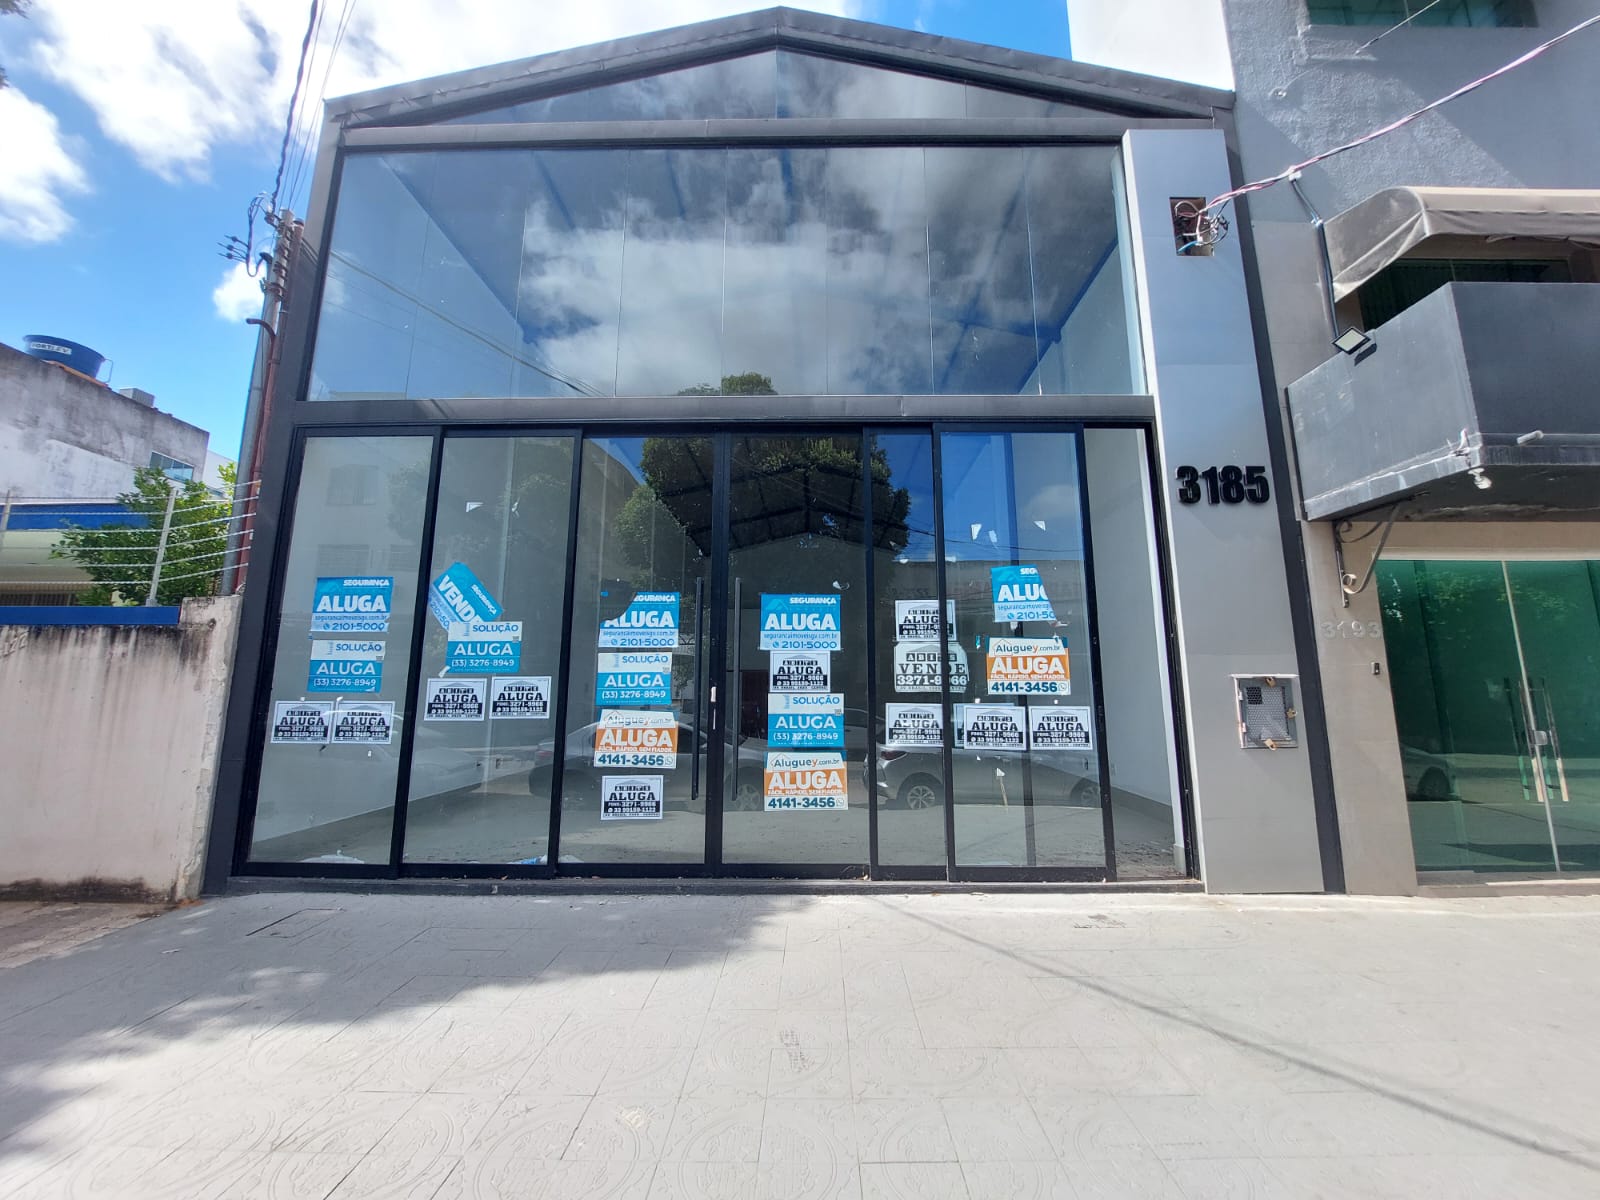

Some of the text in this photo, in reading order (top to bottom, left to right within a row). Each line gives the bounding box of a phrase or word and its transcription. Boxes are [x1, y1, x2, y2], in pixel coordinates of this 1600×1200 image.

[1176, 465, 1270, 505] 3185
[316, 595, 387, 612] ALUGA
[764, 613, 837, 630] ALUGA
[903, 616, 940, 624] ALUG
[332, 623, 385, 631] 2101-5000
[473, 623, 519, 633] SOLUÇÃO
[1320, 621, 1382, 638] 3193
[336, 642, 382, 652] SOLUÇÃO
[454, 643, 513, 656] ALUGA
[996, 645, 1060, 654] Aluguey.com.br
[622, 654, 669, 664] SOLUÇÃO
[906, 653, 957, 662] ABIS
[452, 659, 515, 667] (33) 3276-8949
[991, 657, 1065, 674] ALUGA
[316, 662, 376, 675] ALUGA
[778, 666, 823, 675] ALUGA
[899, 664, 965, 674] VENE
[313, 678, 376, 687] (33) 3276-8949
[604, 674, 664, 687] ALUGA
[897, 675, 967, 685] 3271-966
[992, 682, 1057, 692] 4141-3456
[433, 695, 478, 703] ALUGA
[498, 693, 543, 701] ALUGA
[602, 690, 666, 699] (33) 3276-8949
[792, 695, 840, 706] SOLUÇÃO
[280, 717, 324, 726] ALUGA
[341, 717, 386, 726] ALUGA
[775, 716, 836, 729] ALUGA
[893, 719, 940, 729] ALUGA
[971, 722, 1018, 731] ALUGA
[1037, 722, 1084, 731] ALUGA
[600, 729, 673, 747] ALUGA
[773, 732, 839, 741] (33) 3276-8949
[598, 754, 664, 765] 4141-3456
[774, 758, 840, 769] Aluguey.com.br
[768, 771, 843, 789] ALUGA
[609, 792, 656, 800] ALUGA
[768, 797, 835, 808] 4141-3456
